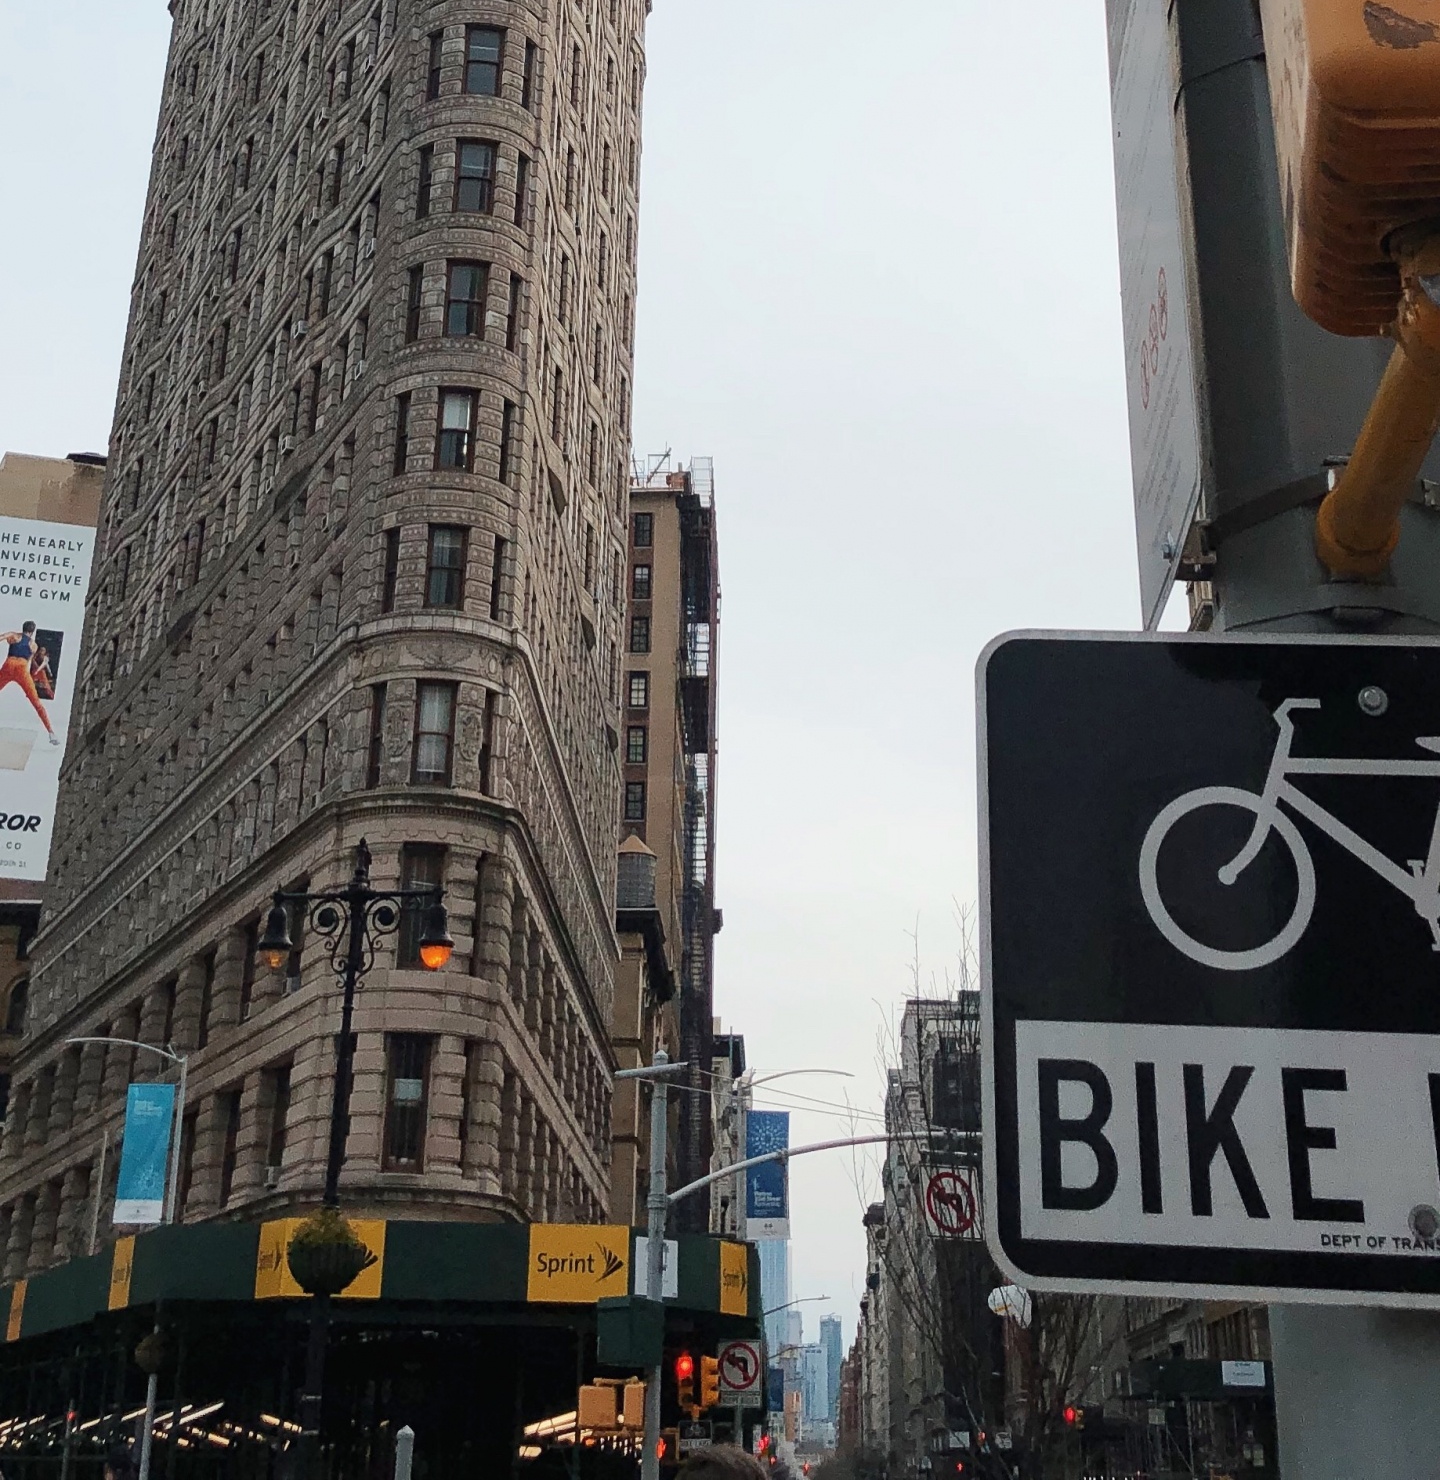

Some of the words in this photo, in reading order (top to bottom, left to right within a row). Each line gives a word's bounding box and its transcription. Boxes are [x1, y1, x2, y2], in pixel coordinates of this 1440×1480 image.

[27, 535, 84, 552] NEARLY
[0, 566, 82, 586] TERACTIVE
[0, 584, 33, 598] OME
[39, 589, 71, 602] GYM
[1037, 1058, 1365, 1223] BIKE
[1321, 1234, 1362, 1248] DEPT
[1366, 1236, 1387, 1248] OF
[537, 1252, 596, 1278] Sprint
